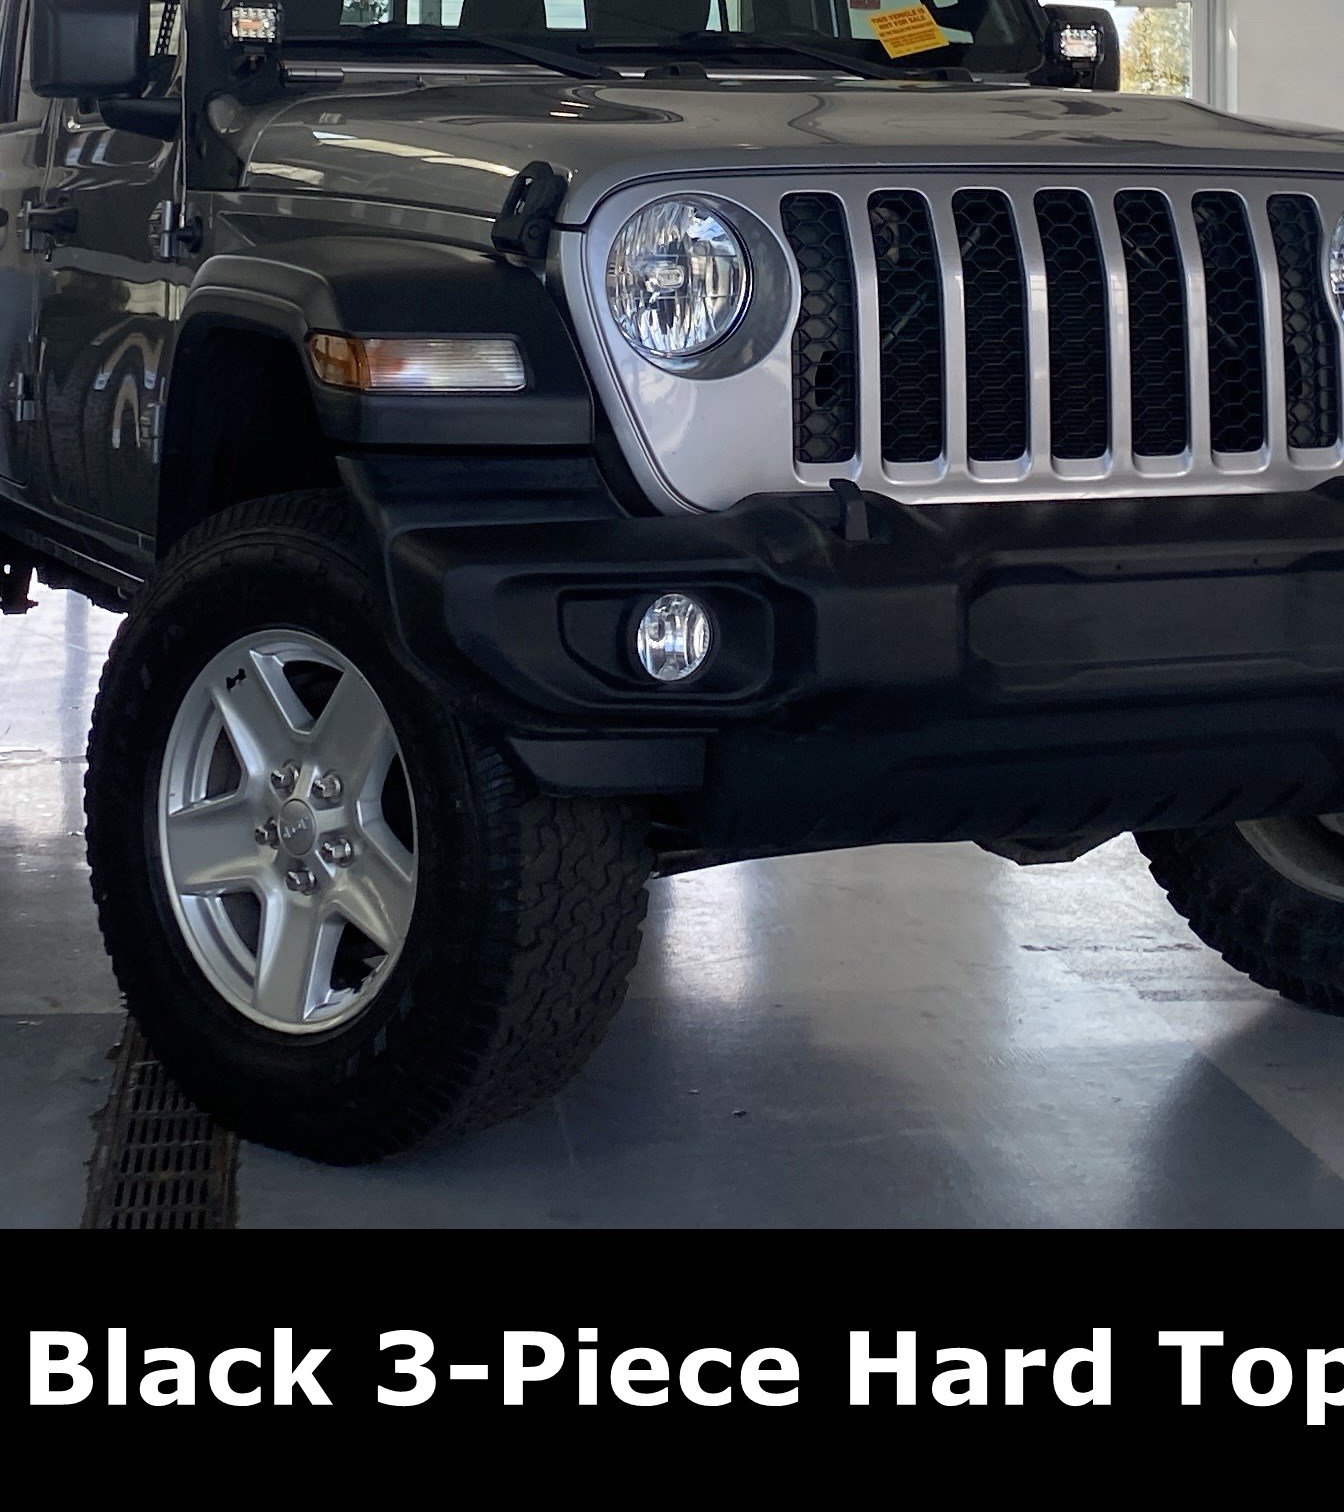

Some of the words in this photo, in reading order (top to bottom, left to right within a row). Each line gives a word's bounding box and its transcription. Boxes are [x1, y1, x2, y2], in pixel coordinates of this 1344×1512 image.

[888, 9, 916, 20] VEHICLE
[878, 21, 892, 29] NOT
[893, 18, 908, 26] FOR
[908, 14, 926, 23] SALE
